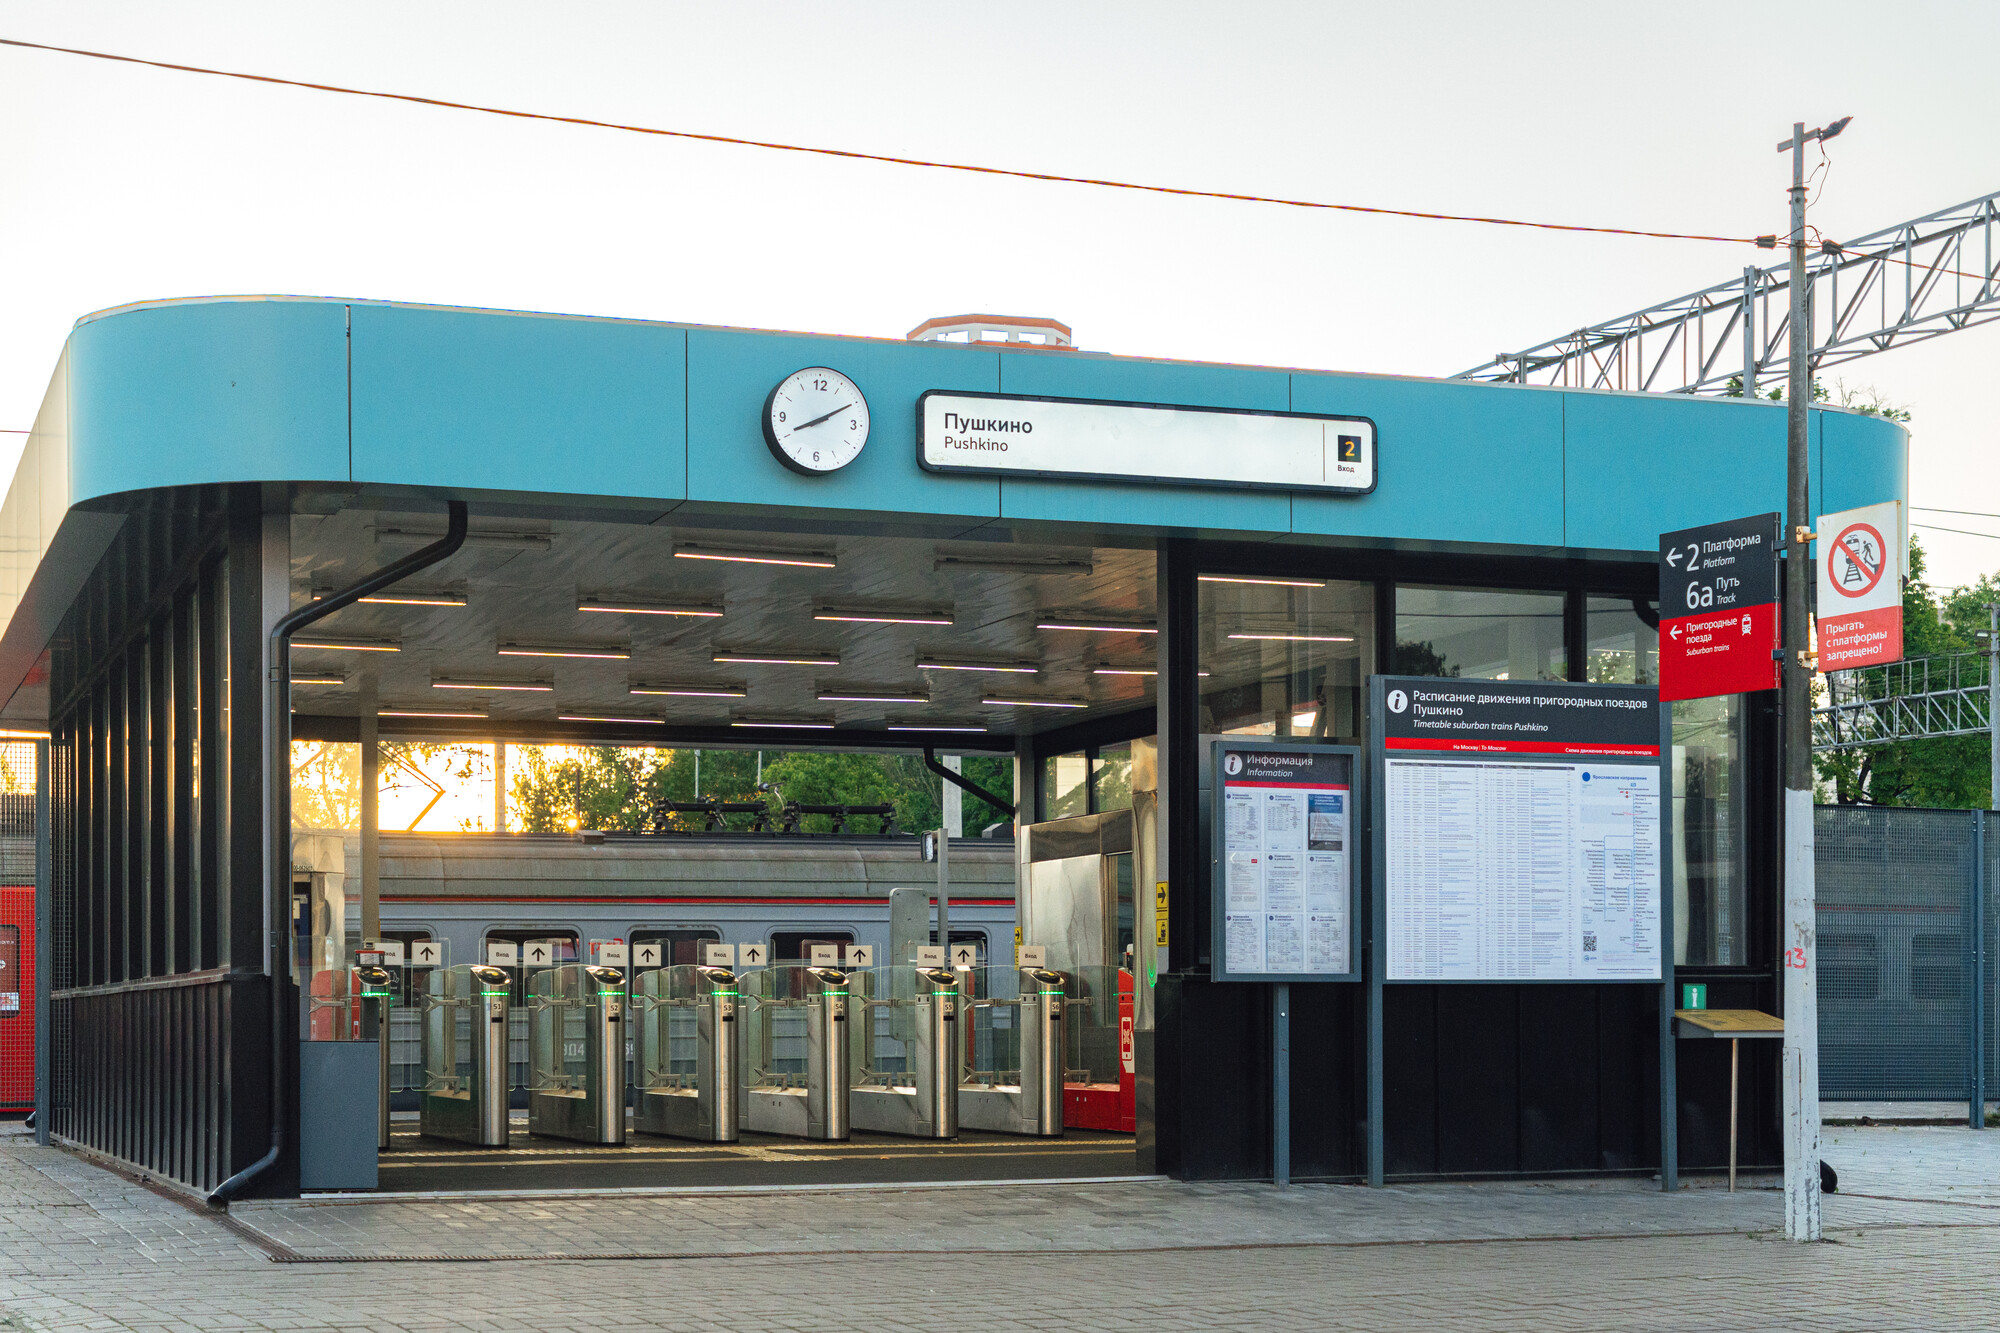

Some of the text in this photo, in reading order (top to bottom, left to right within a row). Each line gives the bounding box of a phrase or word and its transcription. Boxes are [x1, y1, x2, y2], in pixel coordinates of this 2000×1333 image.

[813, 379, 828, 392] 12
[779, 411, 787, 423] 9
[944, 413, 1033, 434] Пушкино
[850, 420, 857, 431] 3
[944, 436, 1009, 452] Pushkino
[1344, 440, 1355, 457] 2
[813, 451, 820, 462] 6
[1337, 464, 1355, 473] Вход
[1686, 534, 1761, 572] 2 Платформа
[1702, 556, 1736, 569] Platform
[1716, 577, 1740, 591] Путь
[1716, 592, 1736, 605] Track
[1686, 617, 1738, 633] Пригородные
[1825, 621, 1864, 636] Прыгать
[1686, 633, 1712, 644] поезда
[1826, 631, 1888, 648] с платформы
[1686, 643, 1730, 656] Suburban trains
[1826, 643, 1882, 661] запрещено!
[1413, 690, 1648, 710] Расписание движения пригородных поездов
[1413, 703, 1464, 717] Пушкино
[1413, 719, 1549, 732] Timetable suburban trains Pushkino
[1247, 754, 1313, 767] Информация
[1247, 768, 1293, 777] Information
[1785, 947, 1807, 969] 13
[610, 1004, 619, 1012] 52
[1052, 1003, 1060, 1011] 56
